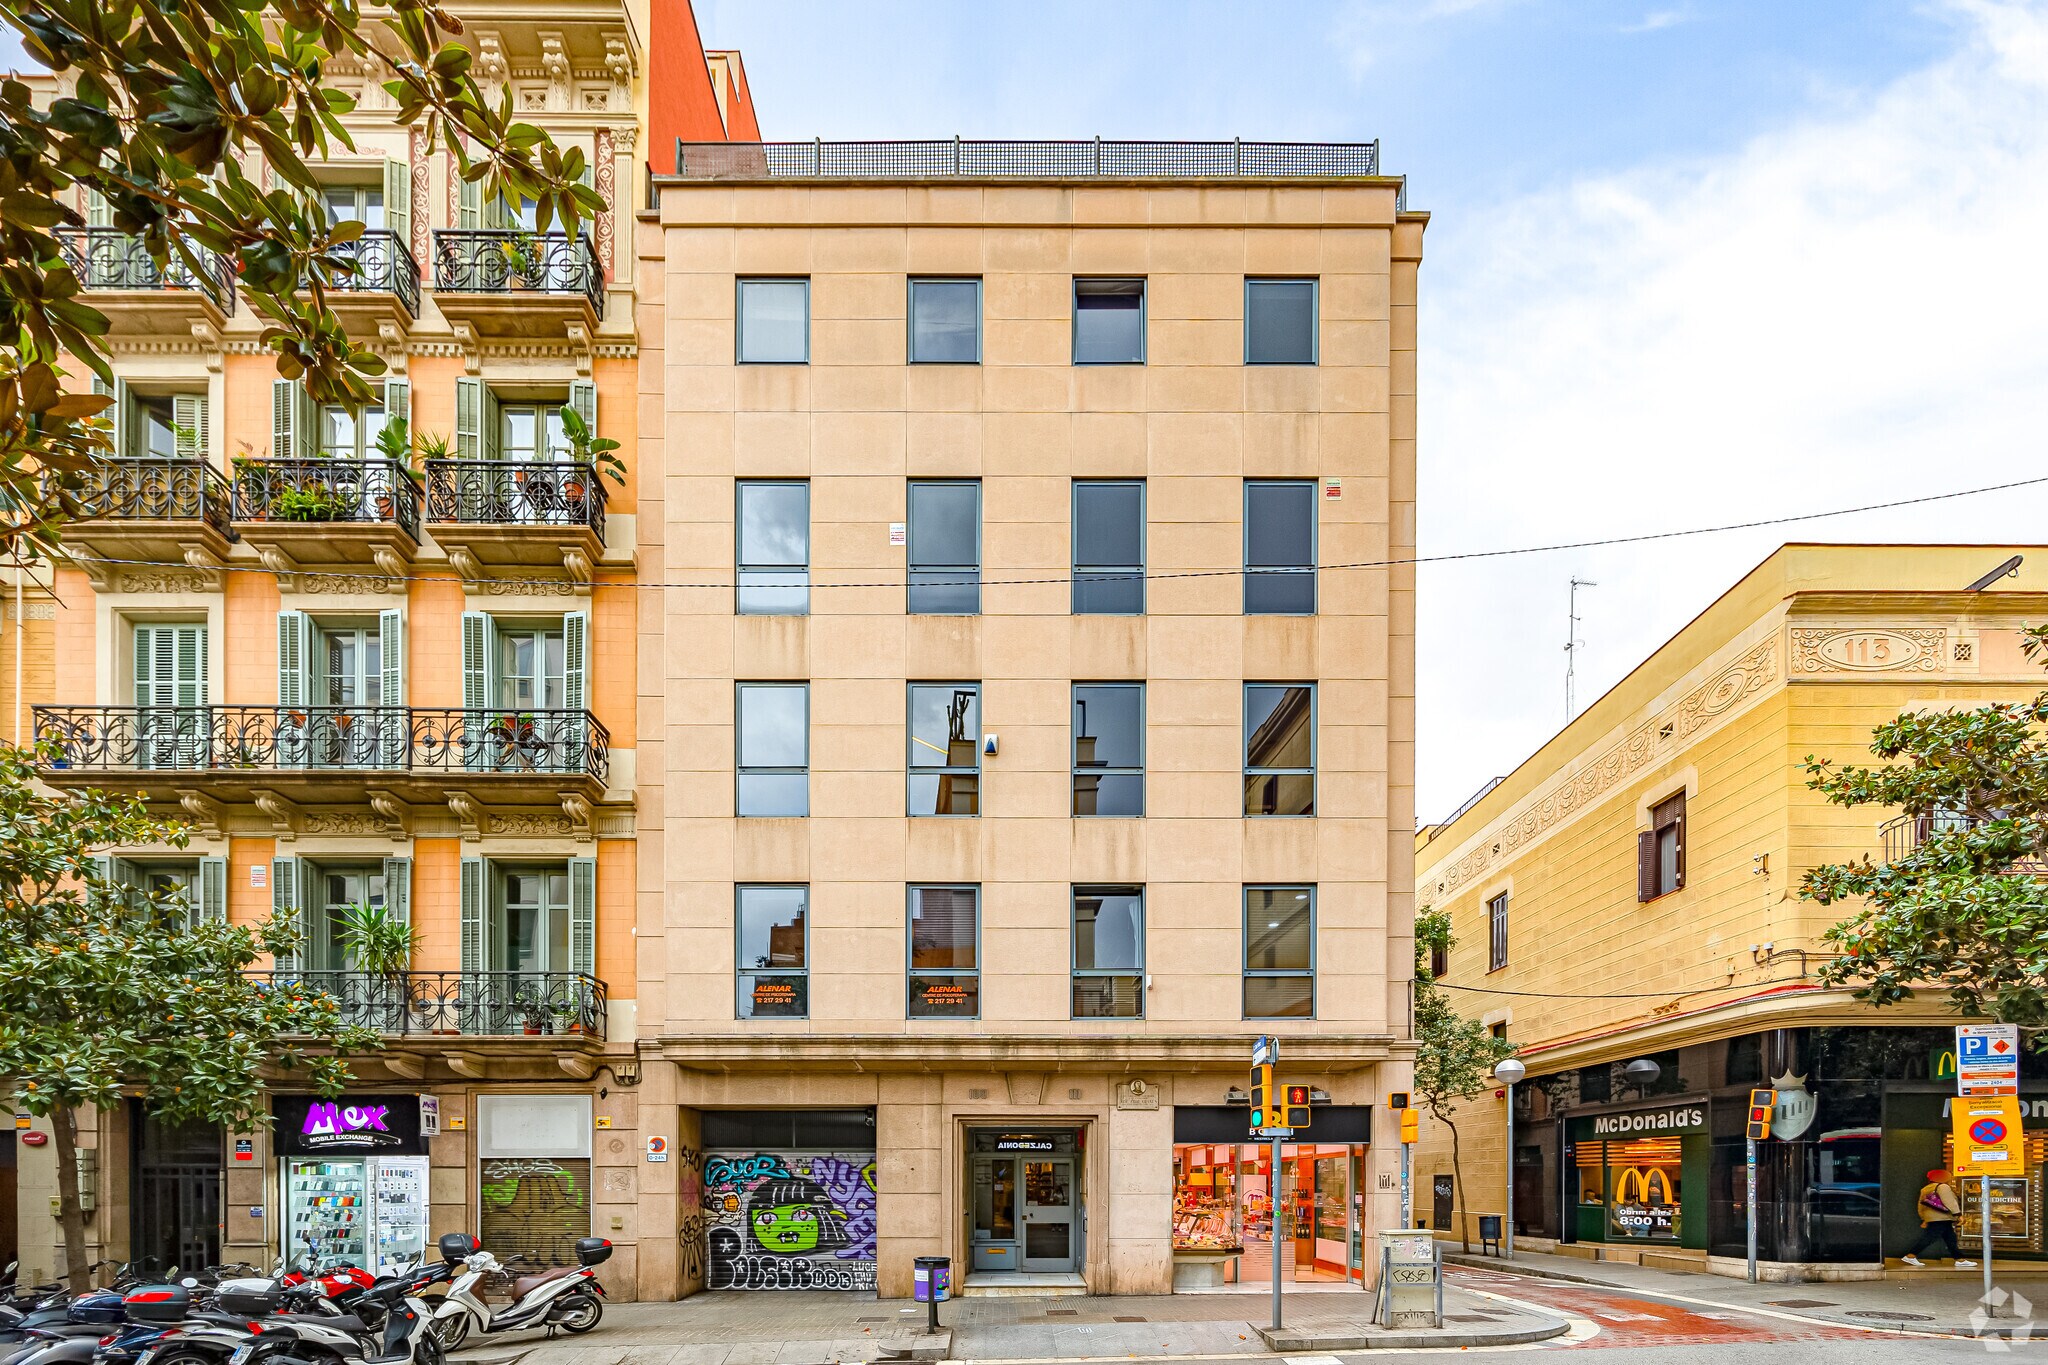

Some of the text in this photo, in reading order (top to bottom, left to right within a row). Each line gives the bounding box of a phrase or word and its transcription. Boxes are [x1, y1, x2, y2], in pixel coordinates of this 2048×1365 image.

[1844, 638, 1891, 663] 113
[1966, 1038, 1981, 1055] P
[1595, 1109, 1703, 1134] McDonald's
[309, 1134, 374, 1144] MOBILE EXCHANGE
[1619, 1208, 1647, 1216] Obrim
[1619, 1216, 1672, 1226] 8:00 h.
